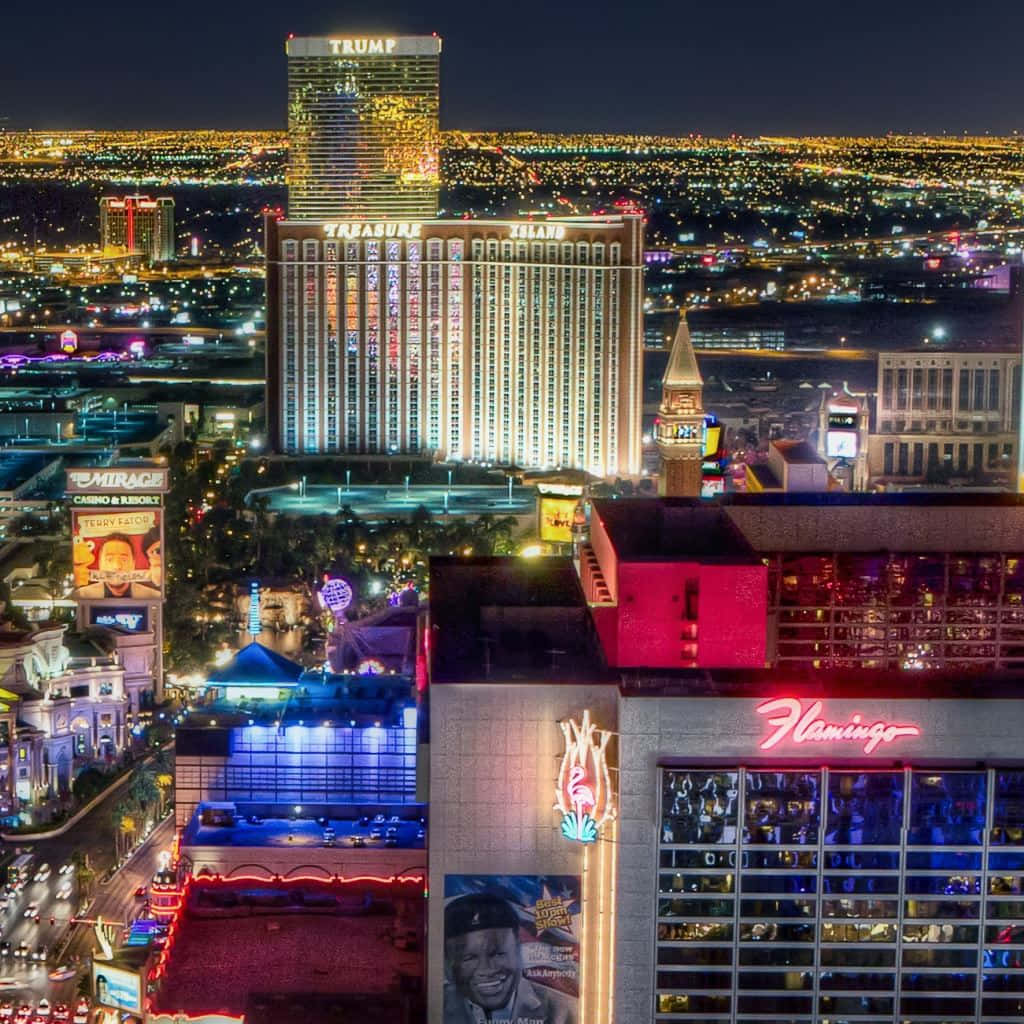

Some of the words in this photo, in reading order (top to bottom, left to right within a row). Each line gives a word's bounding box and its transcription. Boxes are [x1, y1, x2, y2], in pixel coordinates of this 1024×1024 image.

[329, 39, 397, 54] TRUMP
[324, 222, 422, 240] TREASURE
[78, 472, 164, 489] MIRAGE
[73, 495, 110, 505] CASINO
[120, 495, 161, 505] RESORT
[84, 517, 116, 528] TERRY
[756, 698, 919, 754] Flamingo
